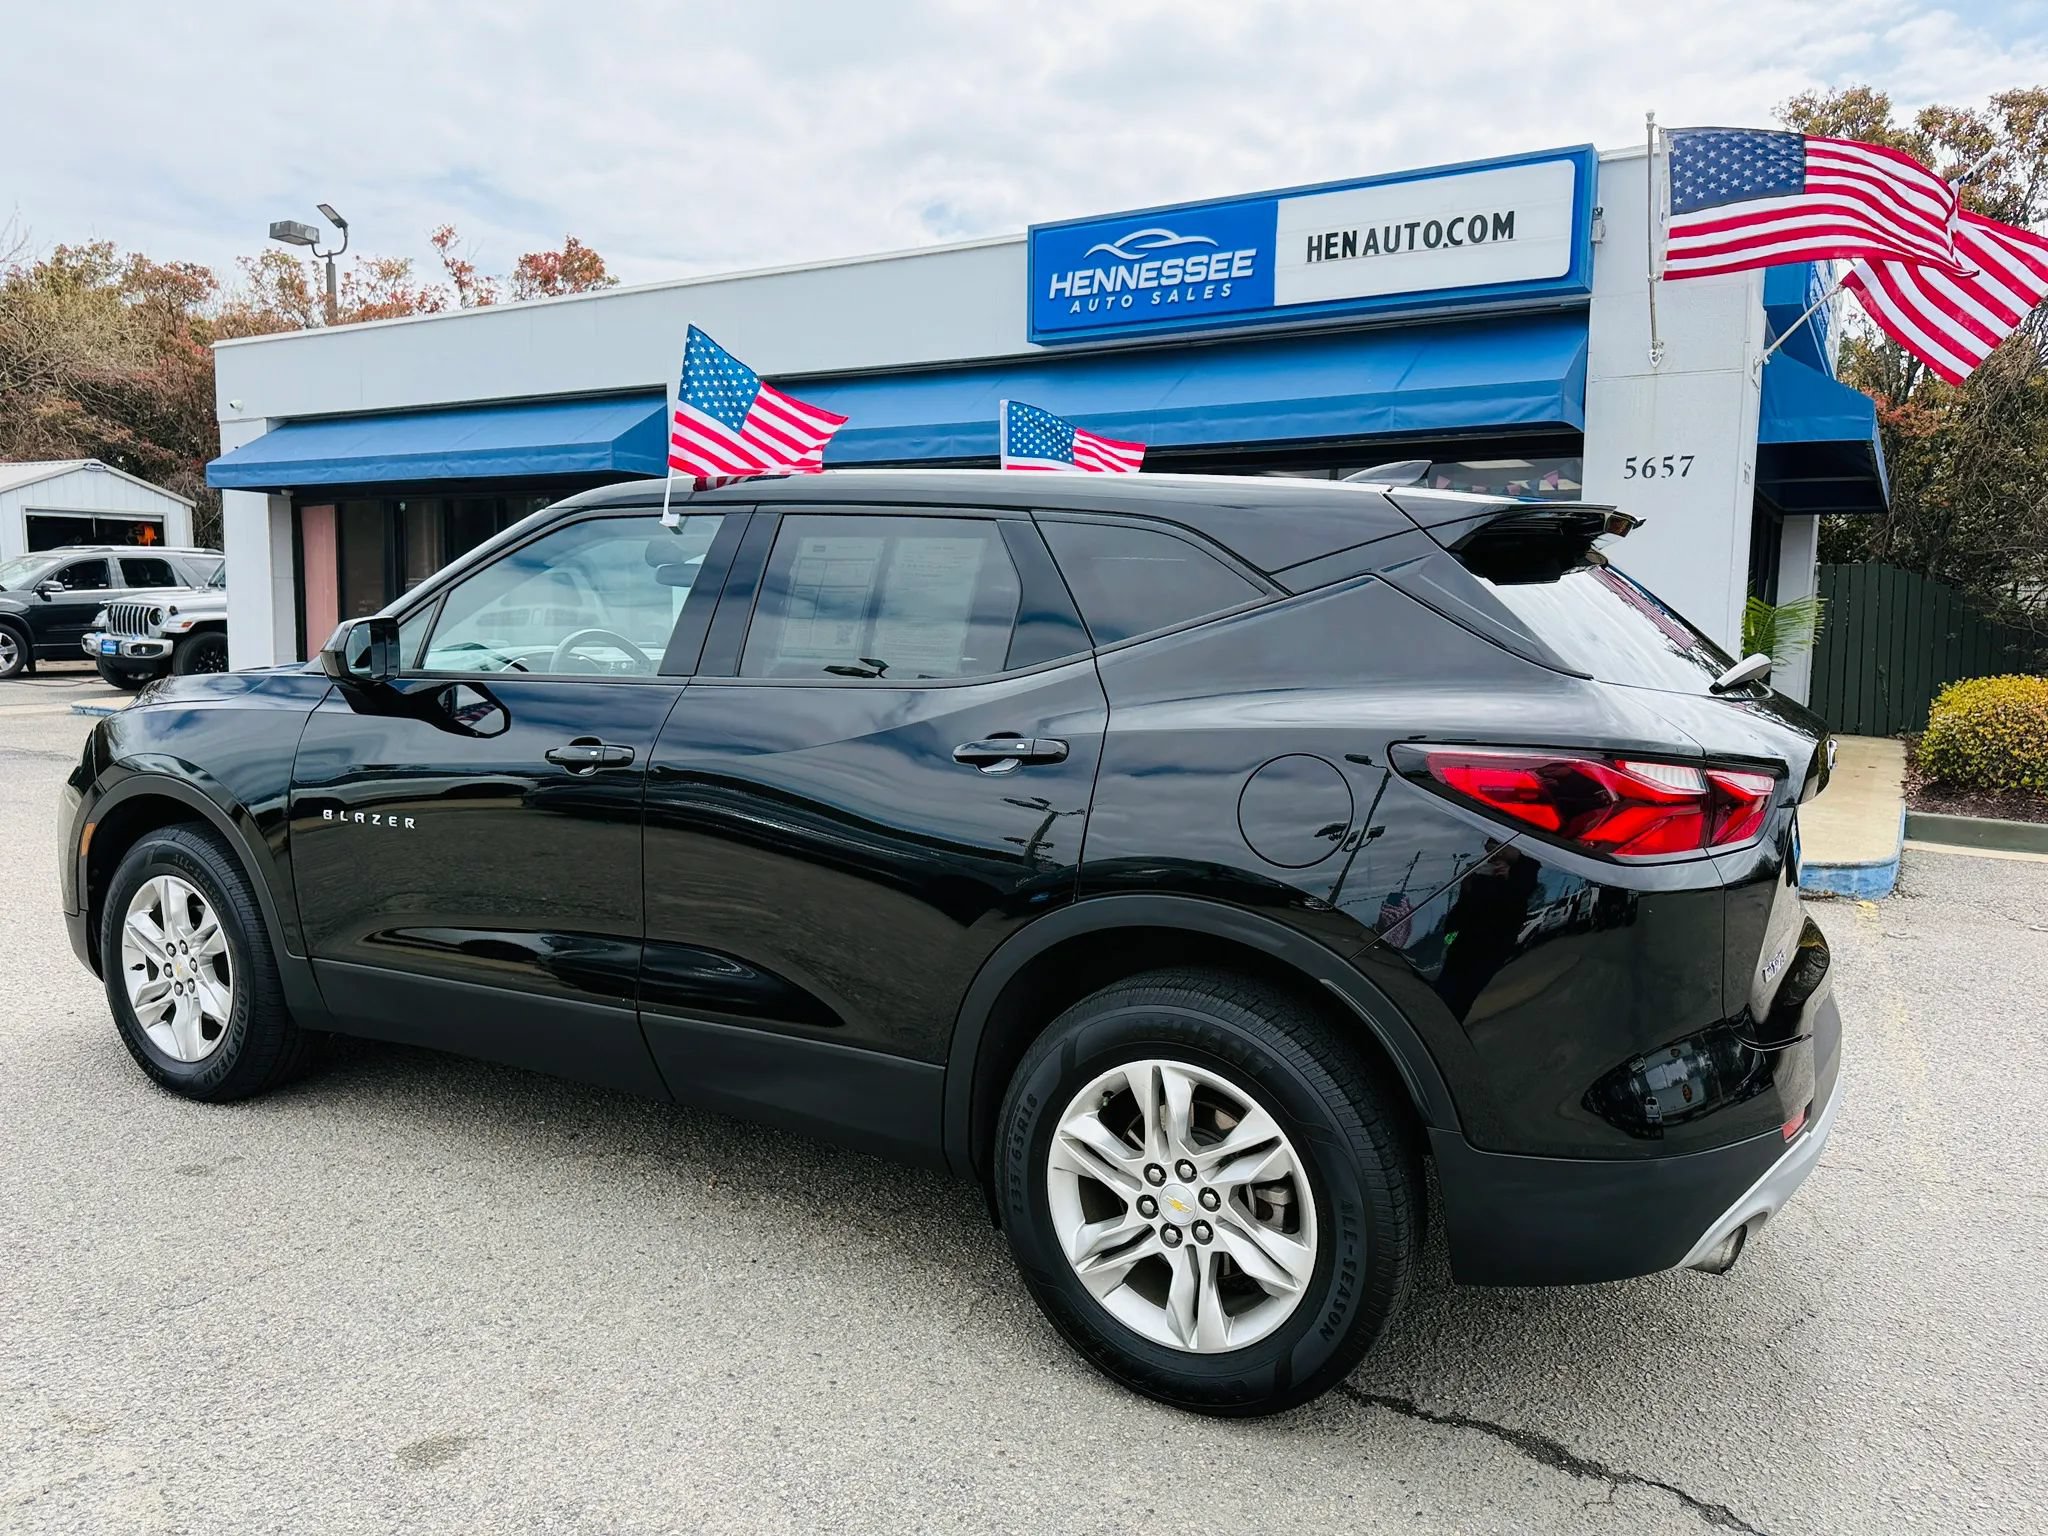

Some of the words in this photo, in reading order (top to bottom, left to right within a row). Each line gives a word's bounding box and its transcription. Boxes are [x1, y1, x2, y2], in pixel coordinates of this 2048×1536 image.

[1306, 211, 1515, 262] HENAUTO.COM
[1049, 248, 1257, 299] HENNESSEE
[1069, 294, 1133, 314] AUTO
[1151, 283, 1232, 305] SALES
[1623, 454, 1696, 480] 5657
[322, 809, 415, 829] BLAZER
[1010, 1093, 1039, 1215] 235/65R18
[1319, 1199, 1358, 1342] ALL-SEASON
